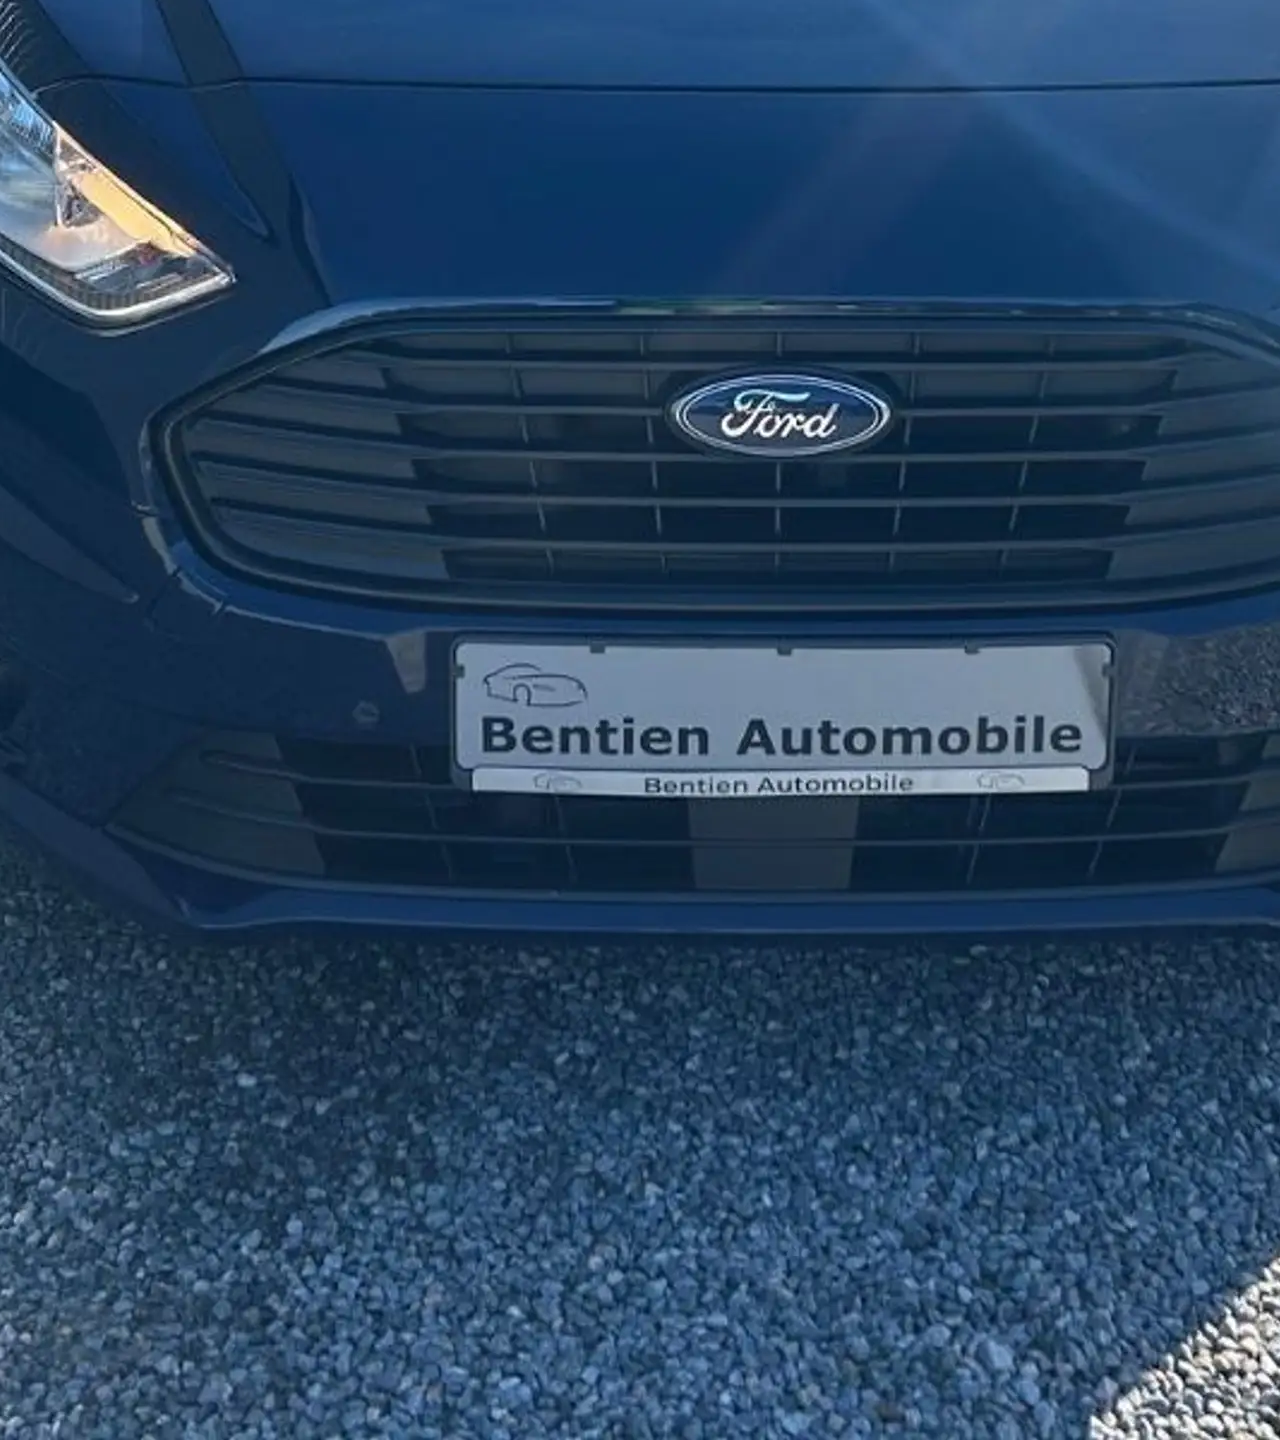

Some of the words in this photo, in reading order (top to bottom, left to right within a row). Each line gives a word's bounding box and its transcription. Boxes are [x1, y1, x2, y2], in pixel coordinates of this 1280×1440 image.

[721, 388, 840, 438] Ford
[480, 715, 710, 756] Bentien
[735, 715, 1084, 756] Automobile
[644, 776, 749, 794] Bentien
[756, 773, 914, 793] Automobile
